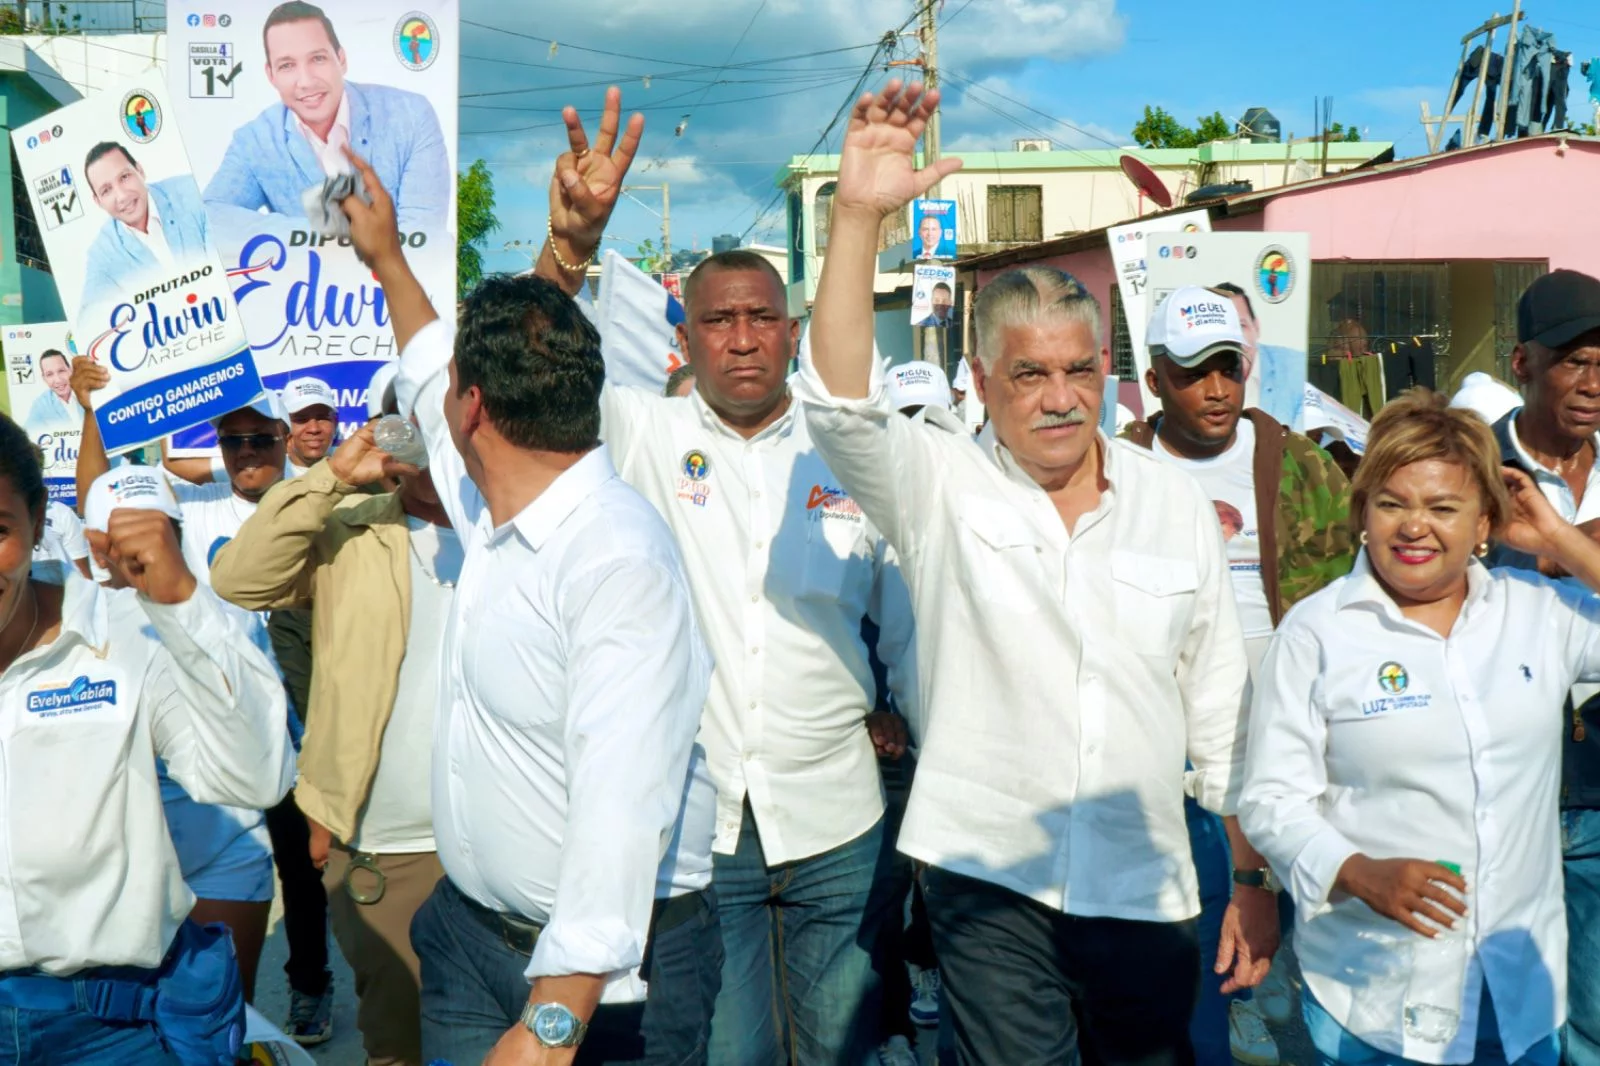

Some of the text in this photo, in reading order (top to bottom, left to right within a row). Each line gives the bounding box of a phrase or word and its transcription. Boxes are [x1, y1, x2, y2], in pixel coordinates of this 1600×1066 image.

[218, 43, 228, 57] 4
[192, 58, 228, 66] VOTA
[201, 66, 215, 96] 1
[61, 167, 72, 185] 4
[51, 201, 64, 226] 1
[134, 265, 214, 305] DIPUTADO
[110, 293, 228, 373] Edwin
[279, 335, 397, 356] ARECH
[107, 363, 246, 425] CONTIGO GANAREMOS
[147, 387, 224, 425] LA ROMANA
[54, 430, 80, 438] DIPUT
[29, 692, 71, 710] Evelyn
[1362, 699, 1389, 716] LUZ
